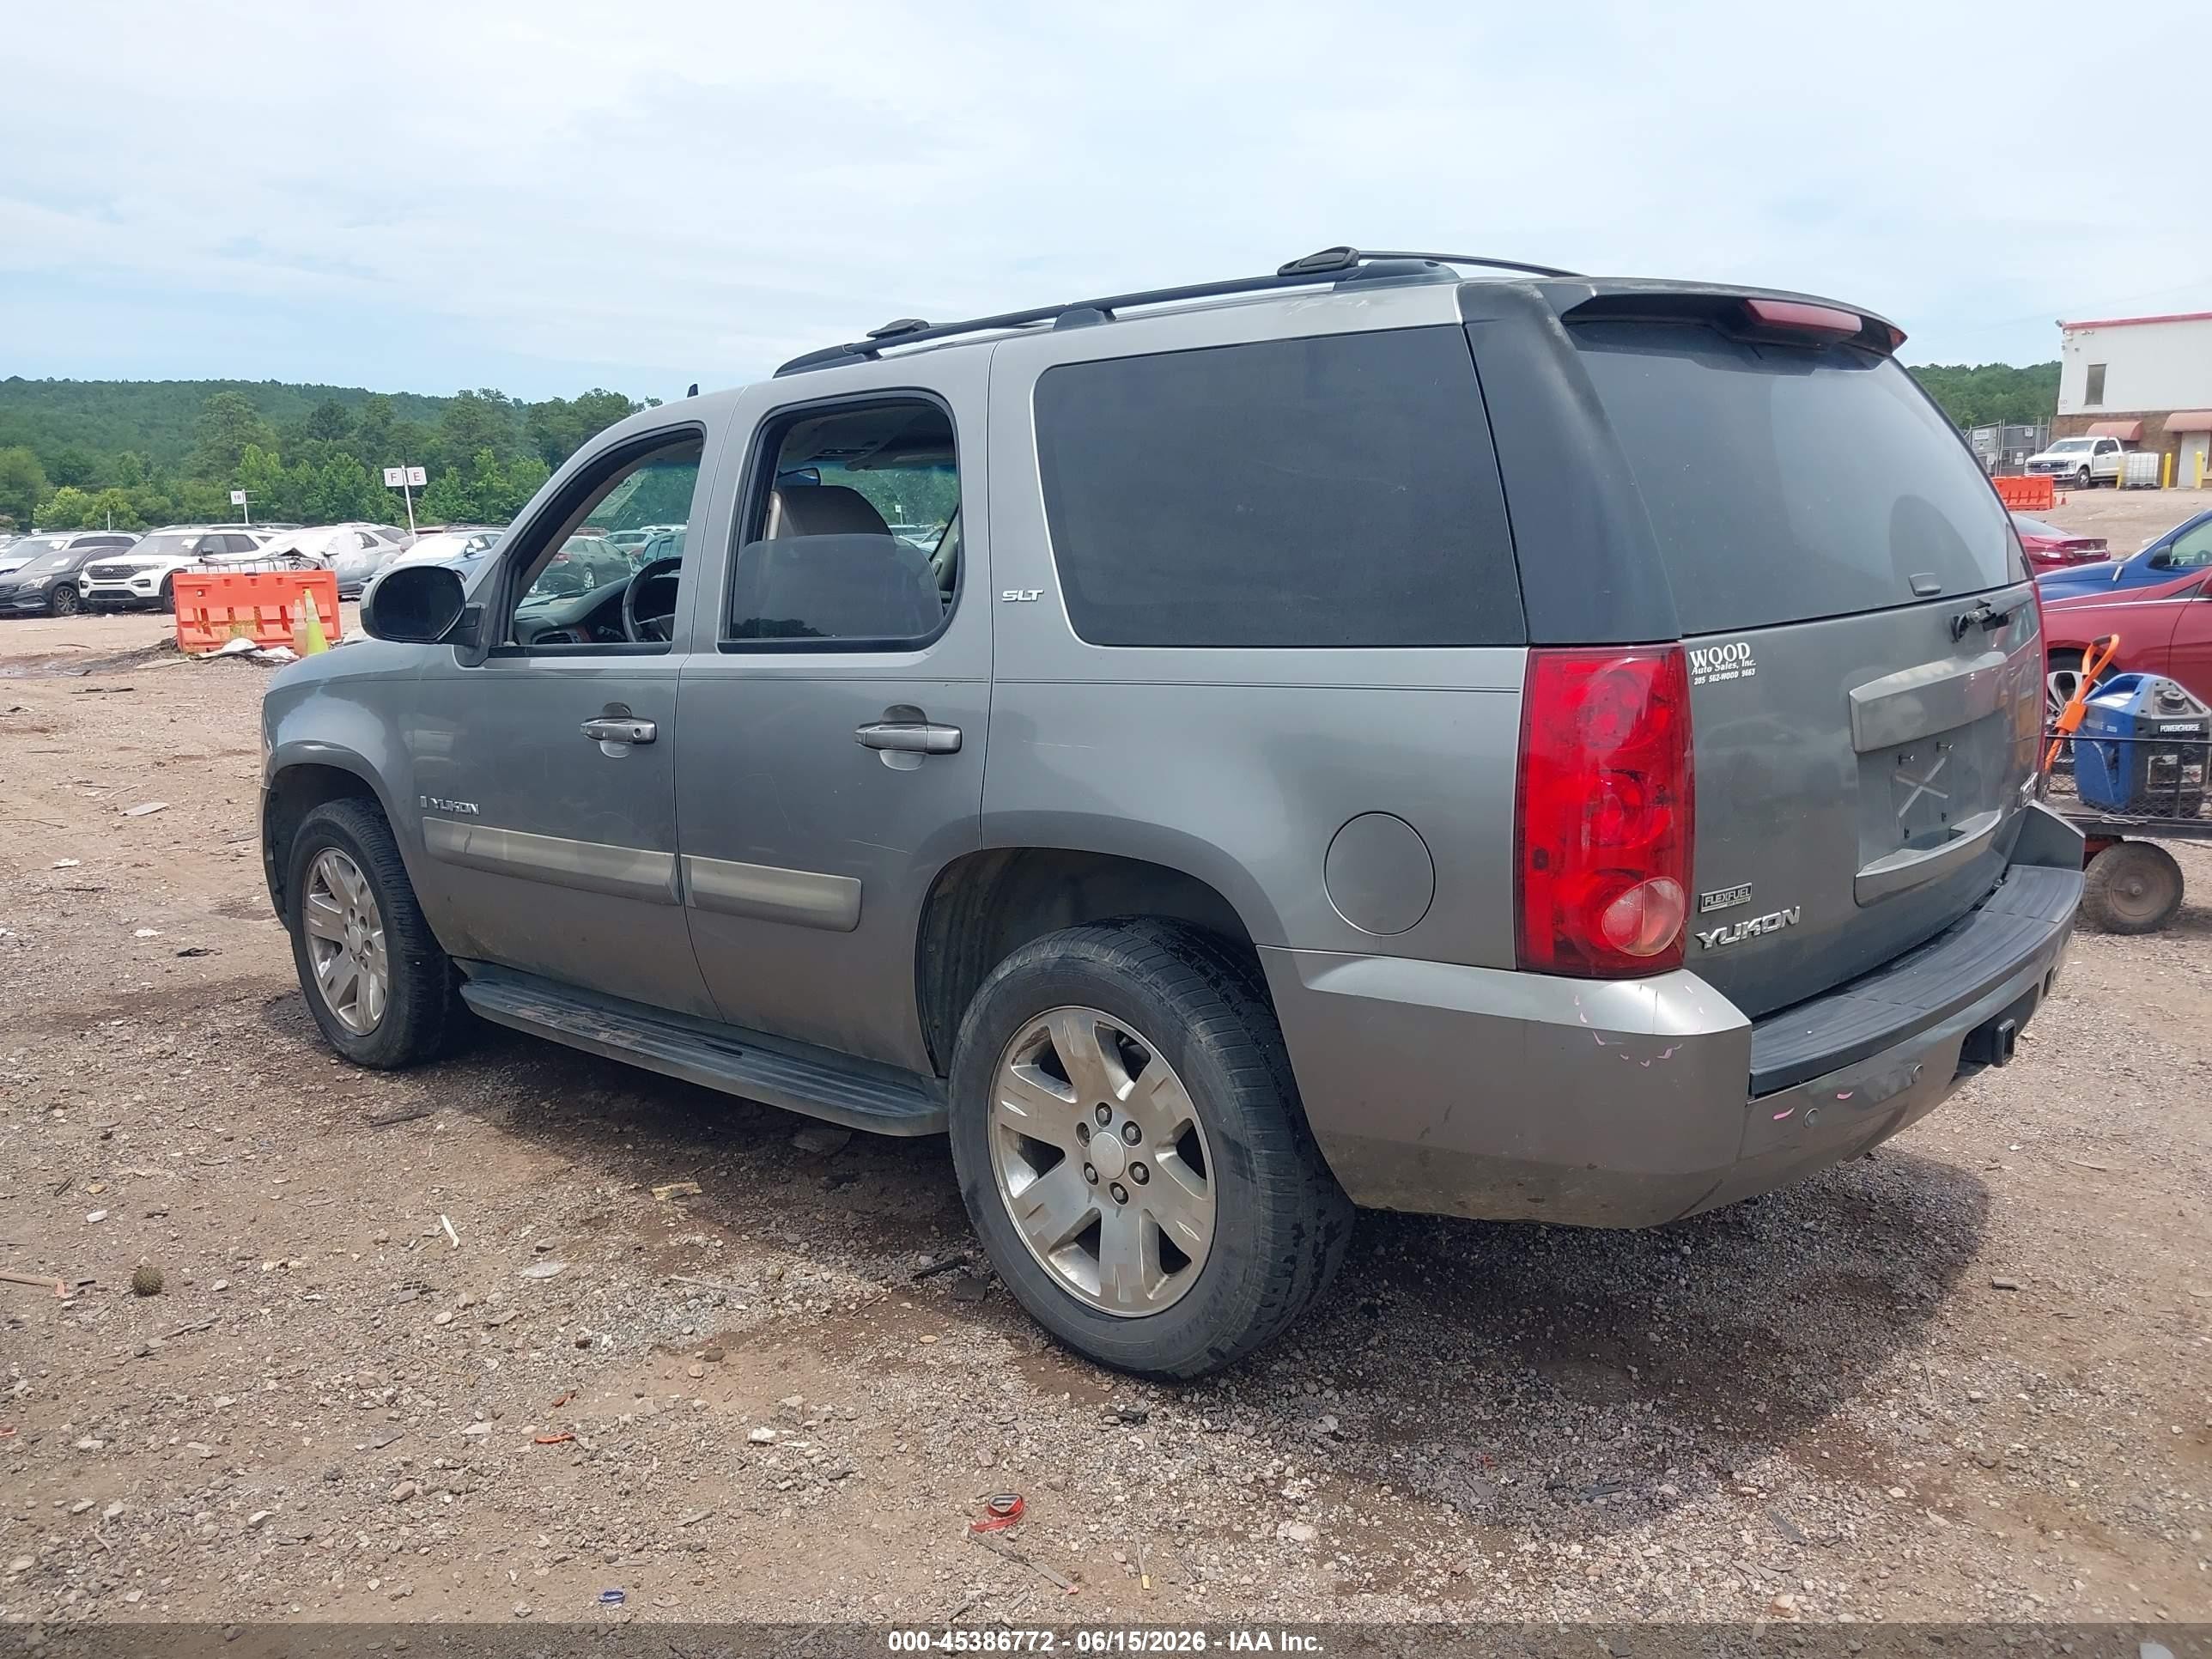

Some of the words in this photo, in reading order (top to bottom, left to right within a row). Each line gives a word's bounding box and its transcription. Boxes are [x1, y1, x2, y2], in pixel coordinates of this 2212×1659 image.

[391, 472, 398, 482] F
[413, 471, 421, 482] E
[1002, 589, 1044, 601] SLT
[1689, 642, 1751, 668] WOOD
[1691, 665, 1713, 676] Auto
[1704, 887, 1750, 907] FLEXFUEL
[1694, 905, 1801, 950] YUKON
